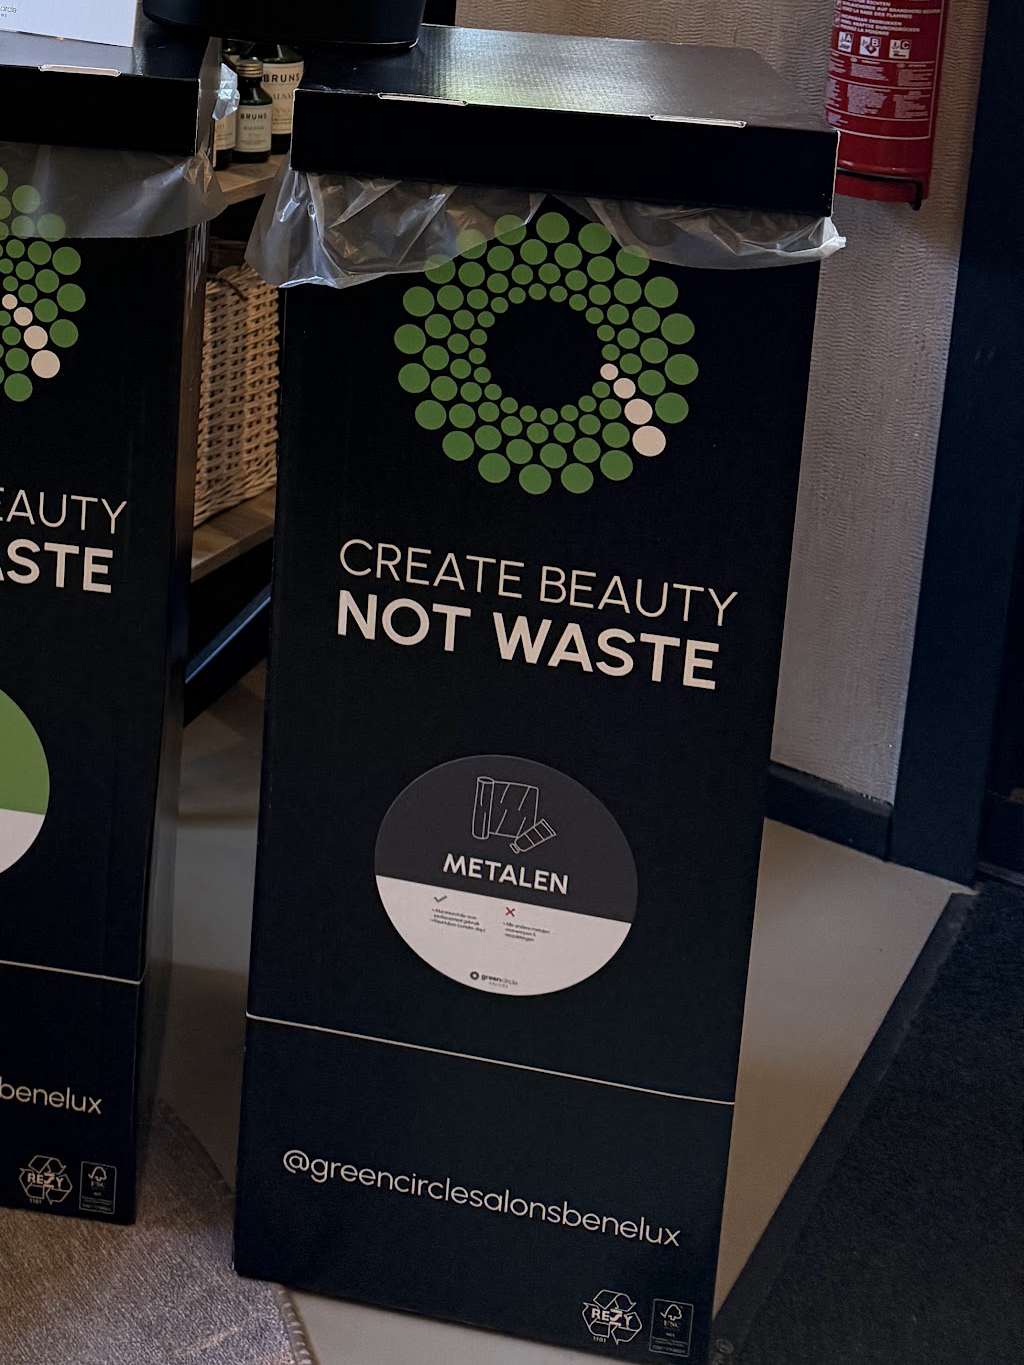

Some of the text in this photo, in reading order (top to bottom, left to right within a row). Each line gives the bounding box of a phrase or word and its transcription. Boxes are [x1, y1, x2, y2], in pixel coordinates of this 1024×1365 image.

[263, 72, 300, 83] BRUNS
[340, 538, 738, 627] CREATE BEAUTY
[337, 589, 720, 690] NOT WASTE
[442, 852, 569, 895] METALEN
[28, 1172, 64, 1191] REZY
[282, 1149, 681, 1248] @greencirclesalonsbenelux
[591, 1308, 633, 1329] REZY
